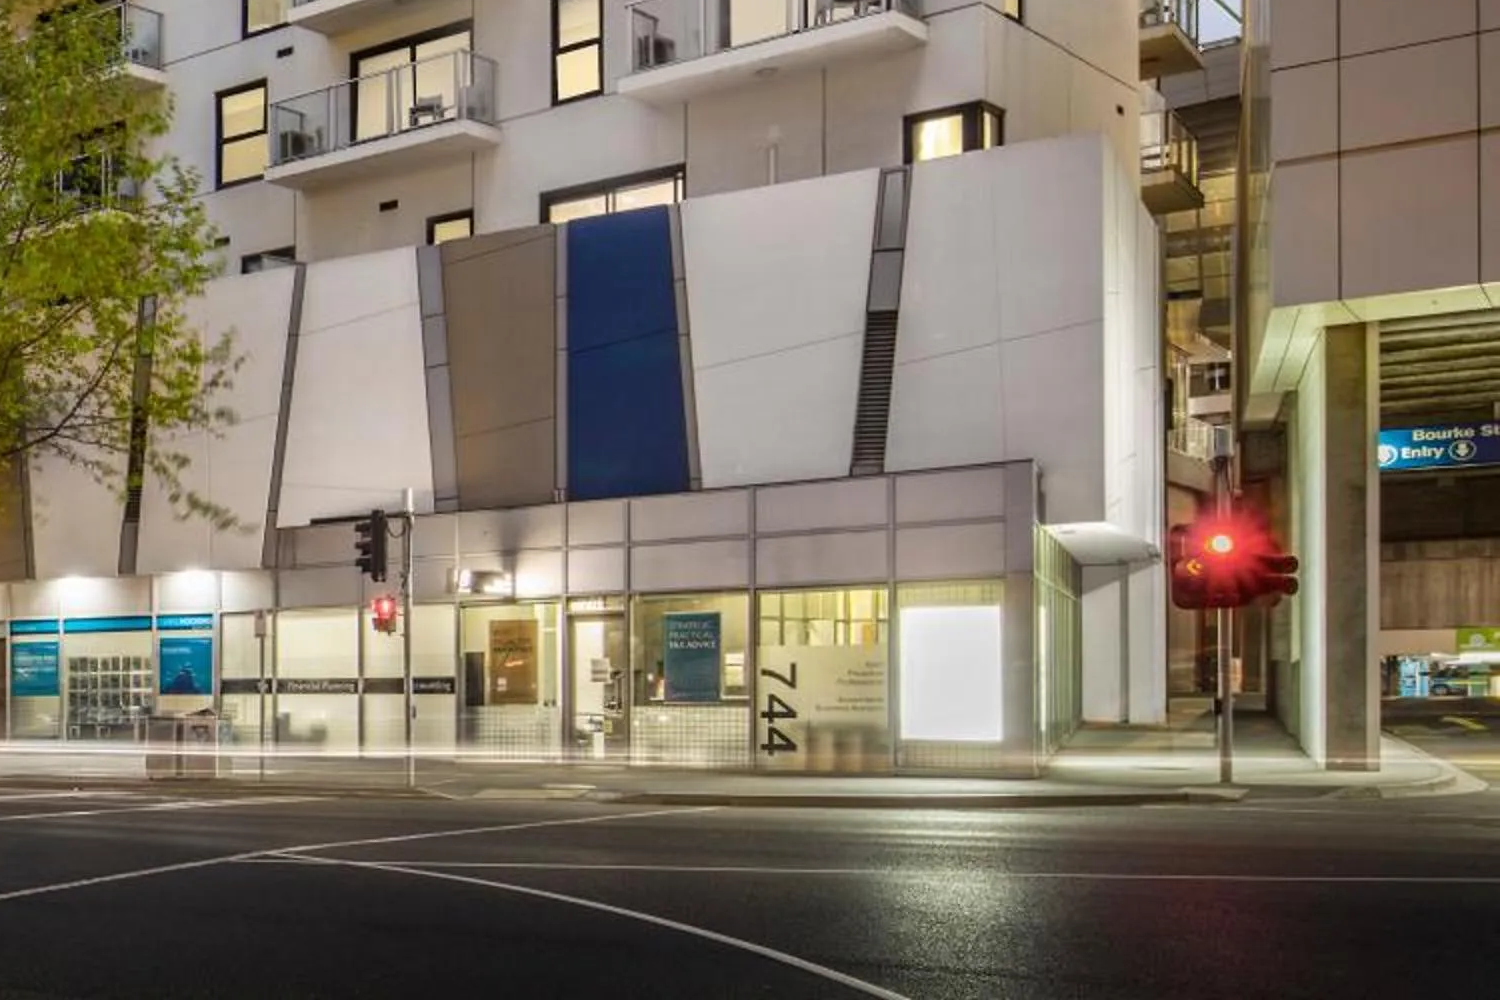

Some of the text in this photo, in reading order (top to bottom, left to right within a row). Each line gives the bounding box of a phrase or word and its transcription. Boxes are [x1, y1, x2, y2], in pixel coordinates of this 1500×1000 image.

[1412, 427, 1475, 441] Bourke
[1401, 446, 1444, 459] Entry
[760, 662, 797, 756] 744
